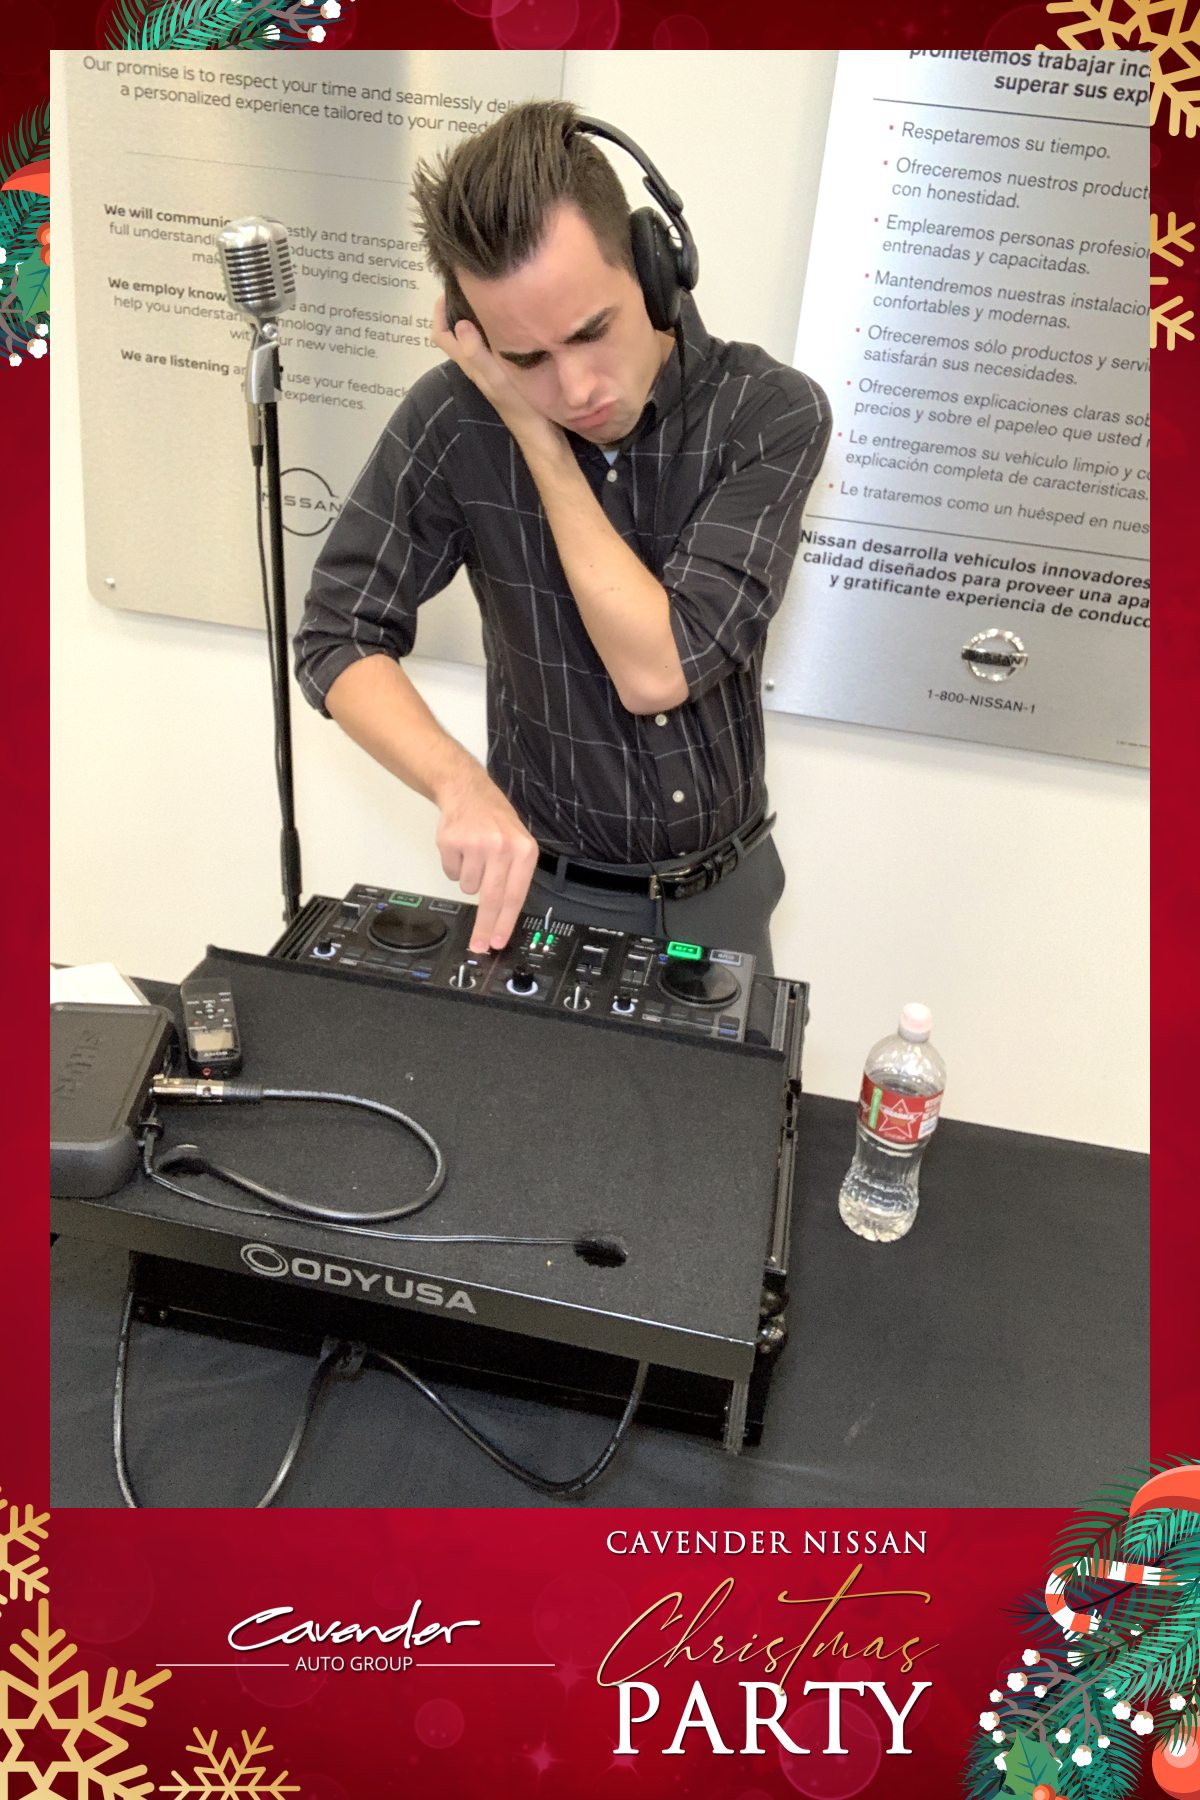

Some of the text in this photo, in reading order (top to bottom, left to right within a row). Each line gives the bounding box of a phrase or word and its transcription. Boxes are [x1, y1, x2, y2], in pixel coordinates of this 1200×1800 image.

[83, 55, 112, 71] Our
[116, 61, 178, 78] promise
[183, 66, 195, 81] is
[199, 68, 215, 83] to
[219, 73, 278, 90] respect
[282, 79, 318, 94] your
[321, 81, 357, 98] time
[361, 87, 392, 101] and
[396, 90, 483, 114] seamlessly
[1038, 51, 1115, 76] trabajar
[1120, 60, 1150, 78] inc
[120, 84, 489, 134] a personalized experience tailored to your need
[994, 75, 1150, 106] superar sus exp
[902, 122, 1110, 161] Respetaremos su tiempo.
[892, 183, 1020, 209] con honestidad.
[896, 157, 1150, 201] Ofreceremos nuestros product
[104, 204, 126, 217] We
[129, 207, 153, 220] will
[286, 226, 317, 242] estly
[321, 230, 347, 243] and
[351, 233, 427, 253] transparen
[109, 222, 129, 236] full
[133, 228, 216, 246] understandi
[338, 250, 364, 264] and
[368, 256, 424, 271] services
[886, 214, 994, 242] Emplearemos
[1000, 231, 1075, 251] personas
[192, 252, 220, 264] mak
[301, 264, 348, 283] buying
[352, 271, 420, 290] decisions.
[882, 238, 1090, 275] entrenadas y capacitadas.
[108, 277, 129, 290] We
[133, 280, 185, 299] employ
[299, 302, 325, 314] and
[329, 305, 412, 326] professional
[416, 317, 433, 330] sta
[874, 269, 993, 298] Mantendremos
[997, 286, 1066, 307] nuestras
[113, 295, 142, 311] help
[145, 302, 170, 313] you
[174, 305, 243, 322] understan
[335, 325, 361, 338] and
[364, 328, 420, 346] features
[873, 295, 1071, 329] confortables y modernas.
[229, 330, 251, 341] wit
[297, 339, 325, 351] new
[329, 343, 378, 358] vehicle.
[867, 325, 970, 351] Ofreceremos
[974, 339, 1007, 355] sólo
[1011, 345, 1093, 367] productos
[1096, 355, 1107, 371] y
[120, 349, 142, 362] We
[145, 353, 166, 365] are
[170, 355, 229, 375] listening
[287, 372, 310, 385] use
[314, 375, 343, 389] your
[863, 348, 1078, 385] satisfarán sus necesidades.
[284, 390, 367, 410] experiences.
[858, 377, 959, 403] Ofreceremos
[963, 391, 1068, 417] explicaciones
[1073, 404, 1120, 424] claras
[854, 401, 911, 418] precios
[914, 408, 924, 423] y
[928, 408, 972, 427] sobre
[976, 415, 990, 428] el
[994, 418, 1057, 436] papeleo
[1062, 426, 1092, 442] que
[1097, 429, 1142, 448] usted
[845, 451, 929, 474] explicación
[933, 463, 1004, 482] completa
[1008, 469, 1028, 486] de
[849, 428, 868, 445] Le
[872, 435, 977, 459] entregaremos
[981, 448, 1000, 462] su
[1072, 457, 1119, 478] limpio
[1122, 467, 1133, 481] y
[840, 480, 1150, 535] Le trataremos como un huésped en nues
[800, 530, 857, 550] Nissan
[862, 539, 948, 563] desarrolla
[1042, 562, 1150, 590] innovadores
[803, 551, 1150, 611] calidad diseñados para proveer una apa
[829, 574, 1150, 629] y gratificante experiencia de conducc
[927, 689, 1036, 714] 1-800-NISSAN-1
